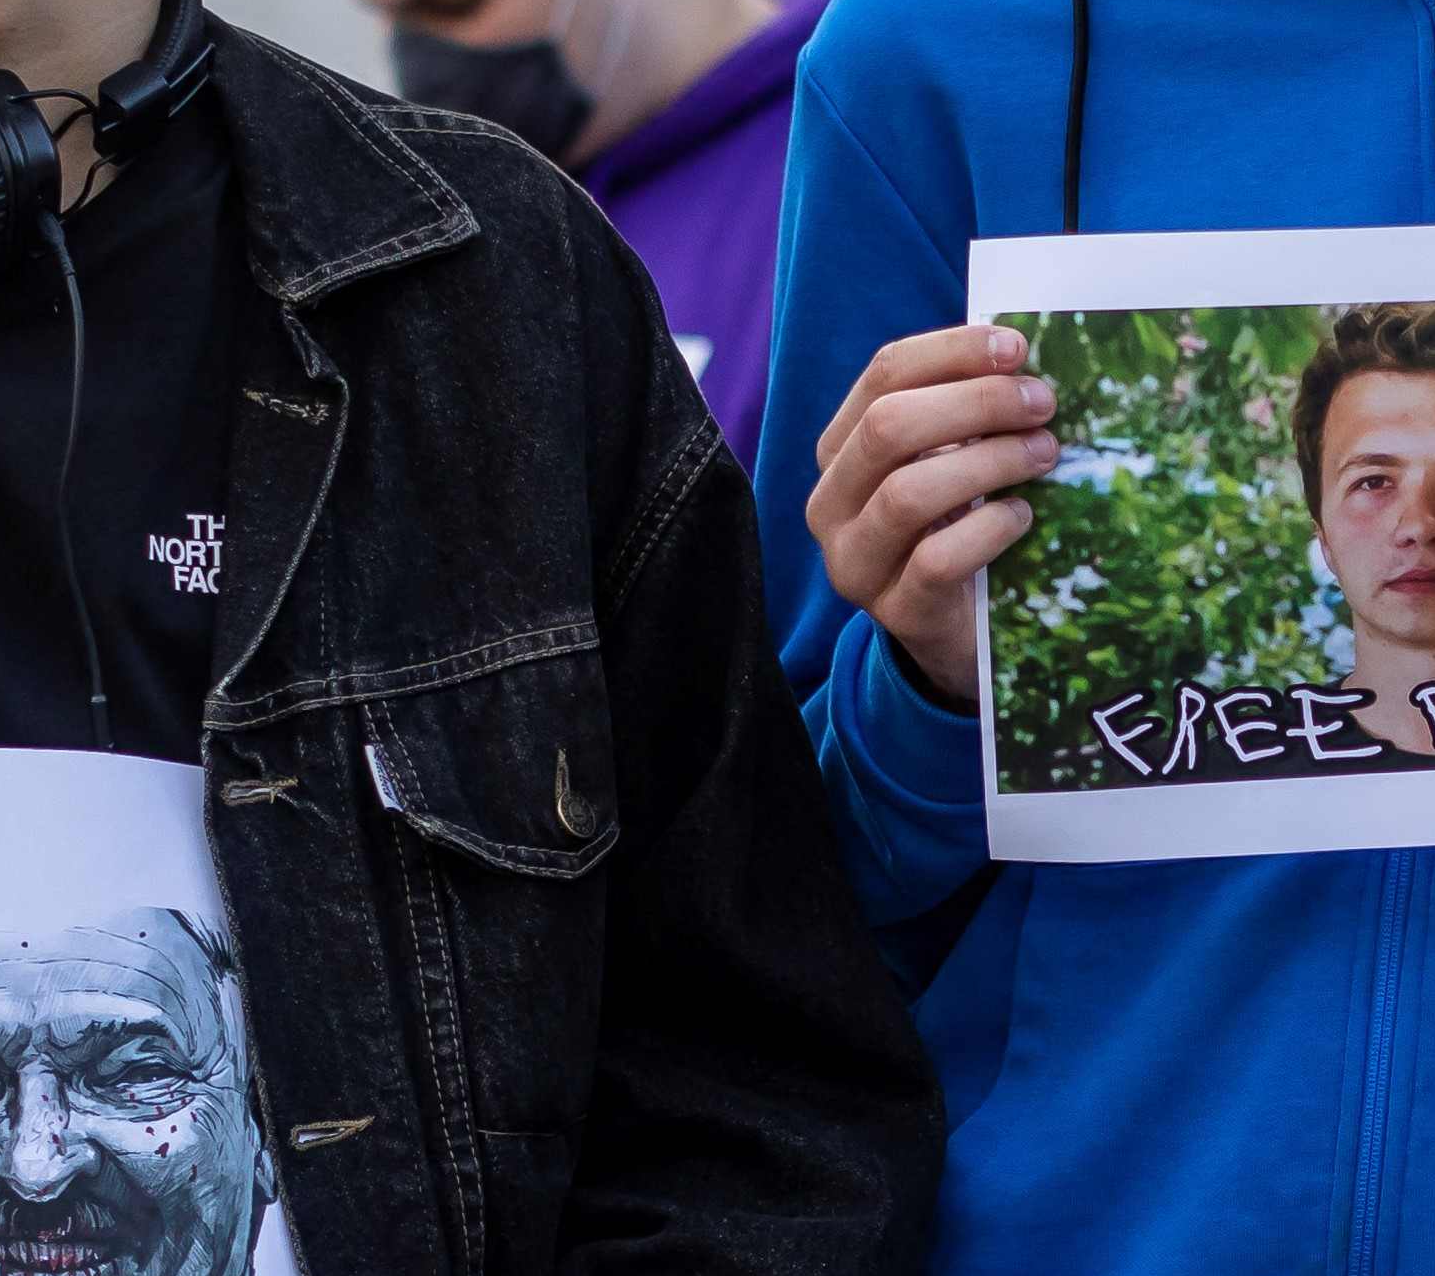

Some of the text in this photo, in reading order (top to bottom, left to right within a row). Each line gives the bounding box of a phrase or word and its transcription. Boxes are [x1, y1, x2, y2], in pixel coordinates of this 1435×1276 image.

[186, 514, 226, 539] TH
[148, 534, 223, 566] NORT
[174, 565, 221, 594] FAC
[1092, 686, 1382, 777] FREE
